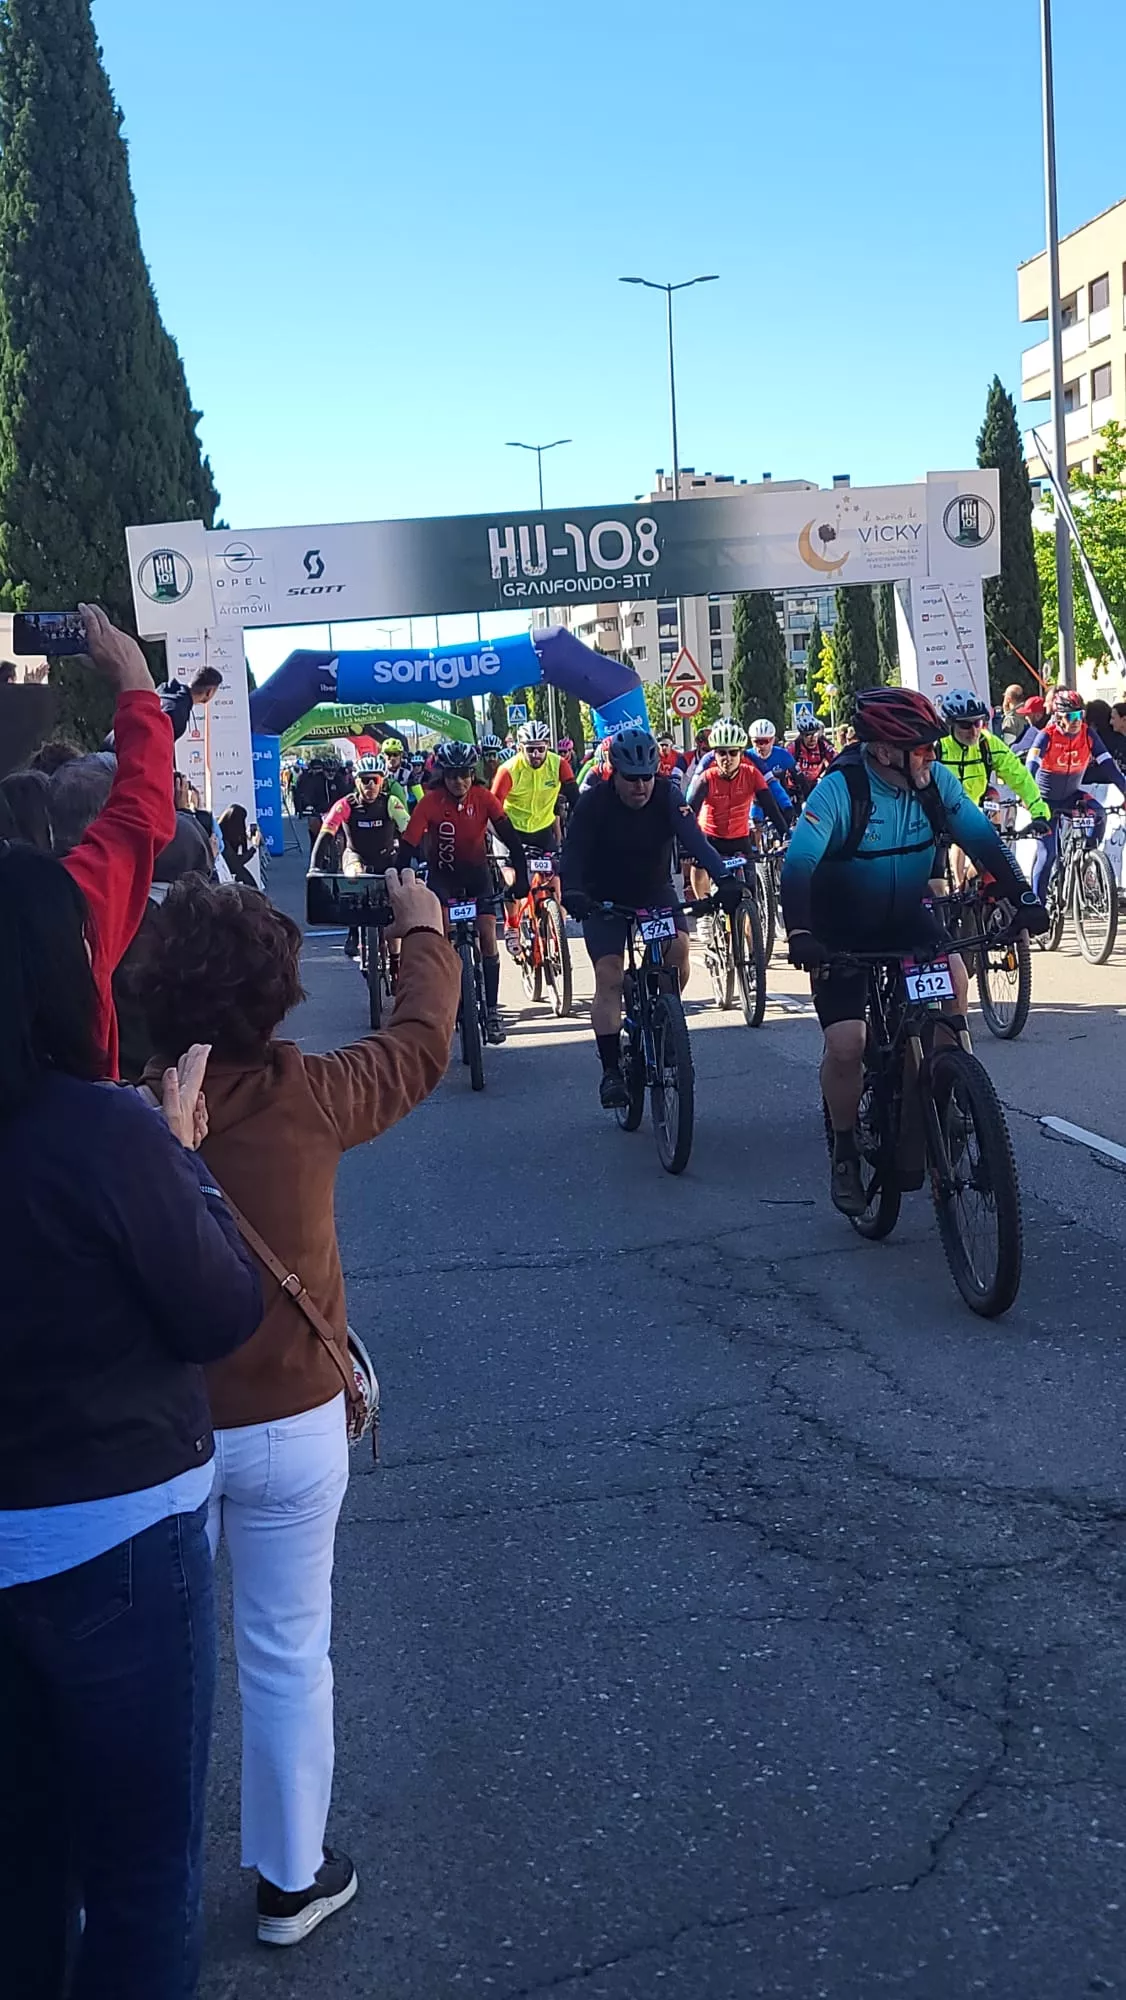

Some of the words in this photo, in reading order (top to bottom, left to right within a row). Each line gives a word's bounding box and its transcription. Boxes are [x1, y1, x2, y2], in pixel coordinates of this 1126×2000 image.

[216, 576, 267, 588] OPEL
[286, 584, 347, 597] SCOTT
[678, 696, 696, 708] 20
[333, 702, 385, 718] Huesca
[454, 906, 472, 917] 647
[915, 976, 946, 993] 612
